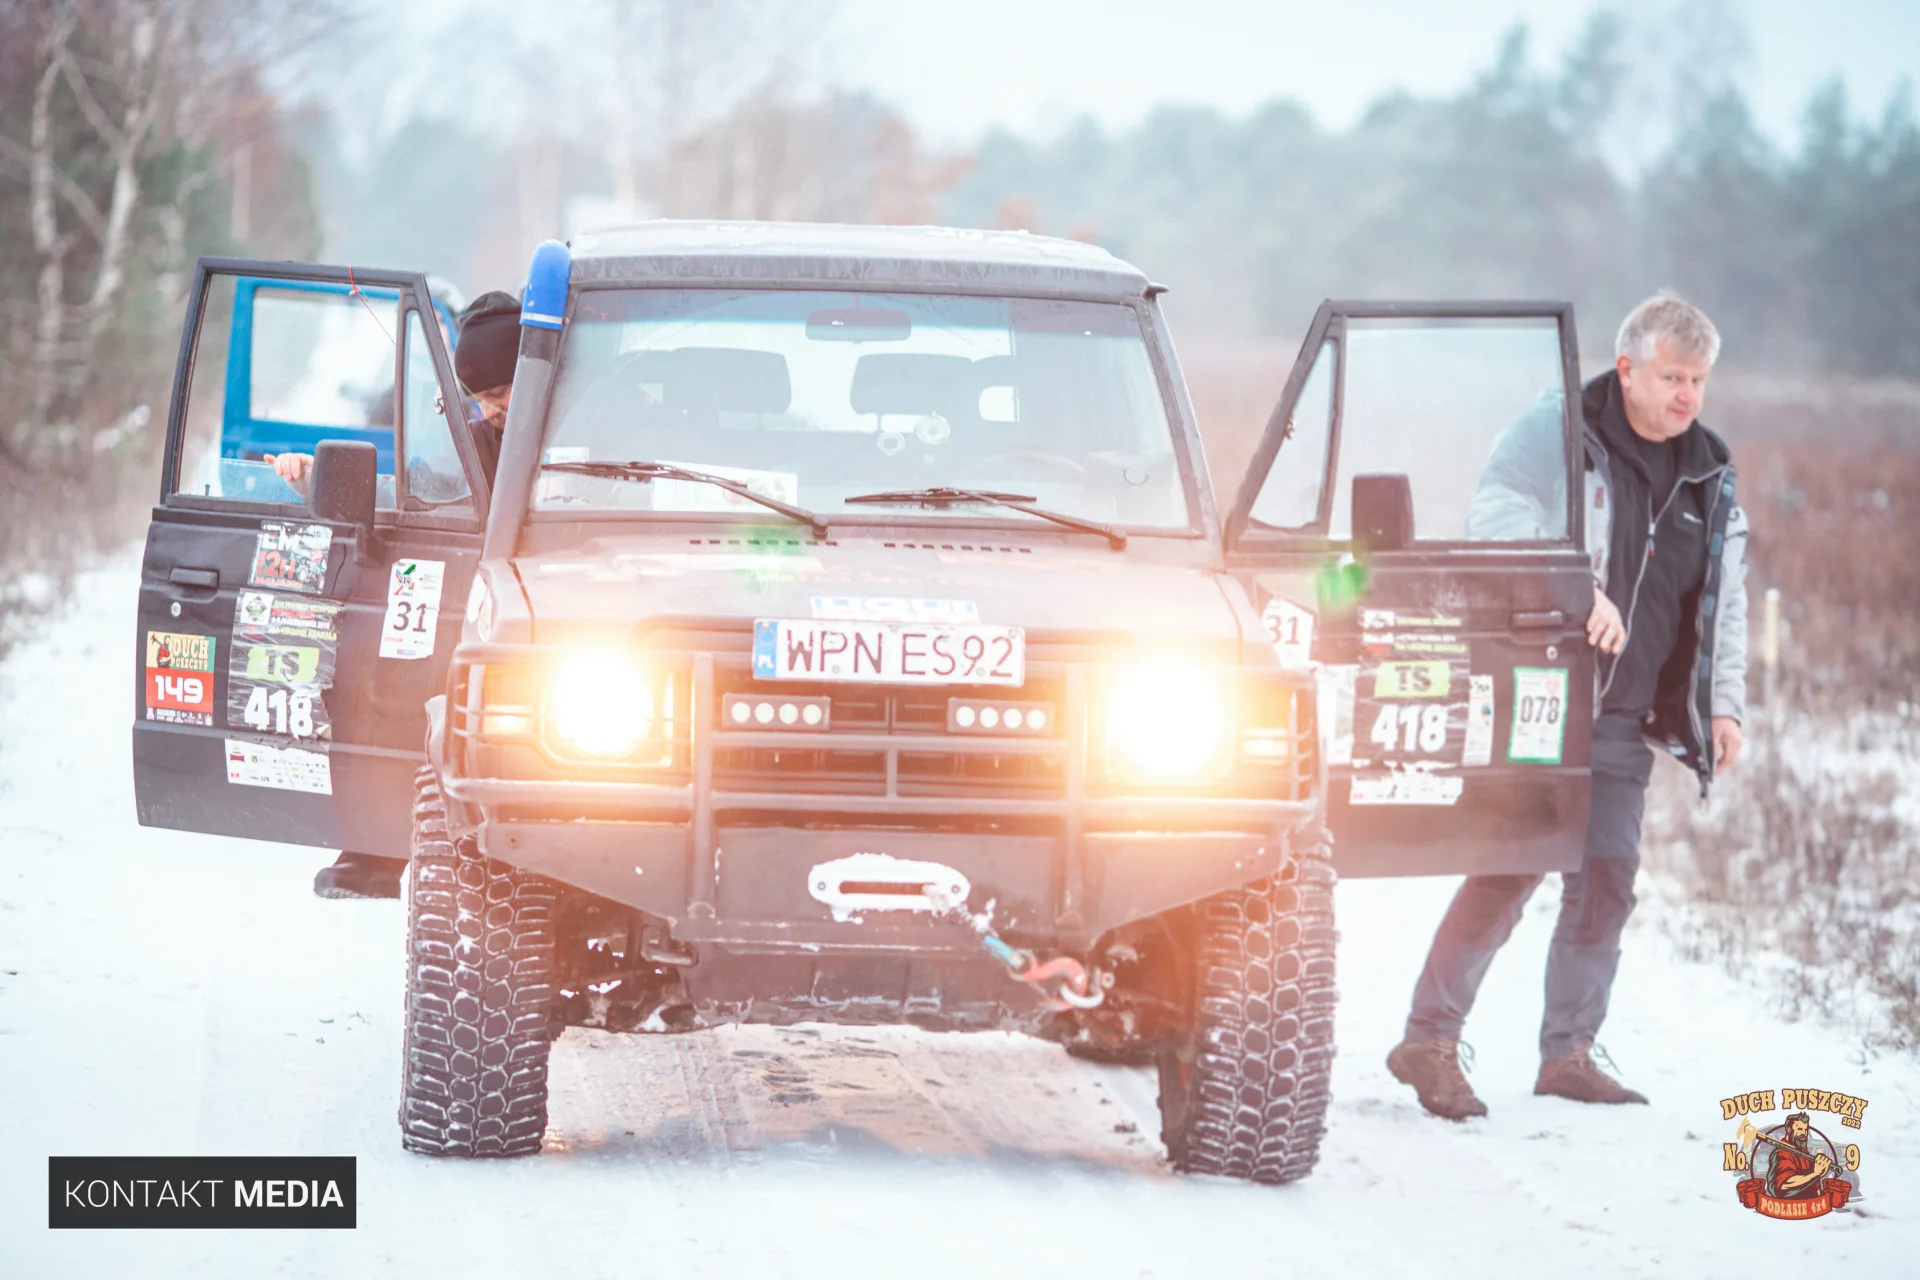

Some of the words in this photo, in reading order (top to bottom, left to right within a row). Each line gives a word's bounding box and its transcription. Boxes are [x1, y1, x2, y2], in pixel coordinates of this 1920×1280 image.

[393, 601, 427, 632] 31
[1266, 614, 1301, 645] 31
[171, 637, 210, 660] DUCH
[265, 649, 299, 675] TS
[757, 656, 775, 669] PL
[787, 629, 883, 674] WPN
[901, 633, 1013, 677] ES92
[155, 674, 203, 704] 149
[1395, 665, 1432, 691] TS
[244, 687, 313, 738] 418
[1520, 695, 1560, 724] 078
[1371, 703, 1448, 753] 418
